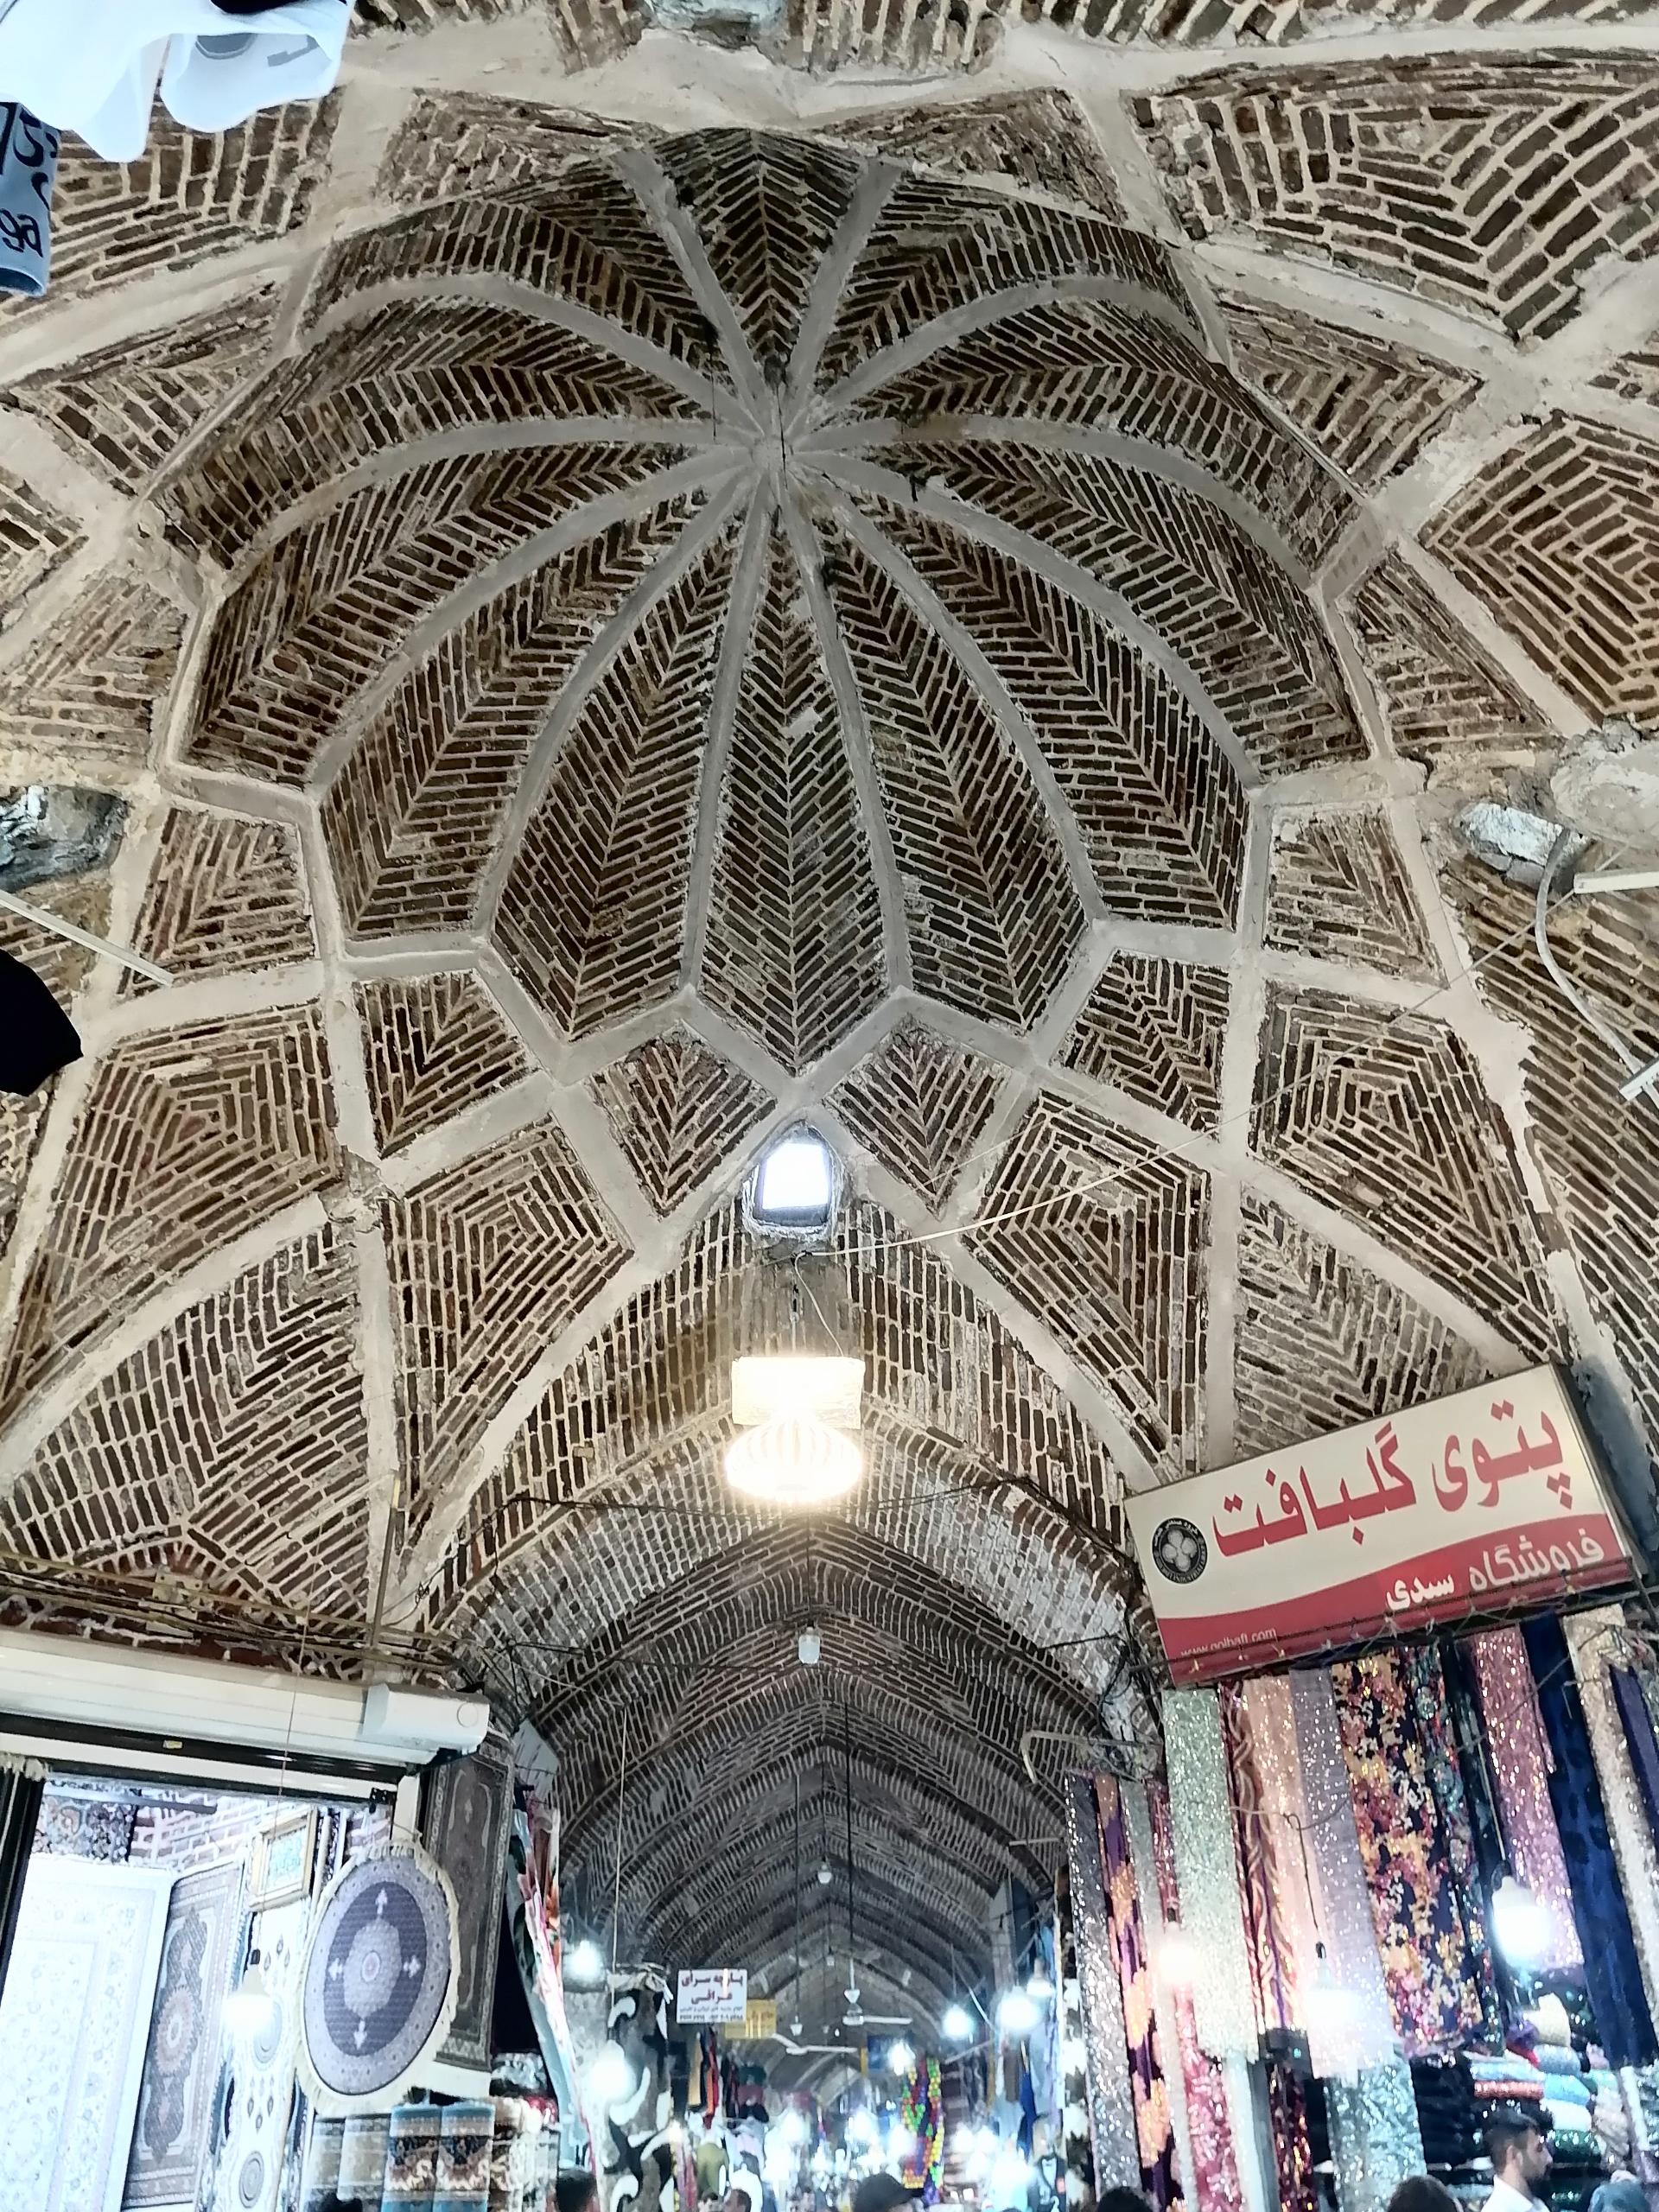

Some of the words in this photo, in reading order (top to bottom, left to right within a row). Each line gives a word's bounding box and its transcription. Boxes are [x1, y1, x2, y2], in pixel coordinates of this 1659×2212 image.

[1432, 1399, 1573, 1510] پتوی
[1212, 1421, 1417, 1557] گلبافت
[1386, 1573, 1455, 1611] سدی
[1469, 1528, 1605, 1592] فروشگاه
[1179, 1627, 1277, 1657] wwwgolbaftcom
